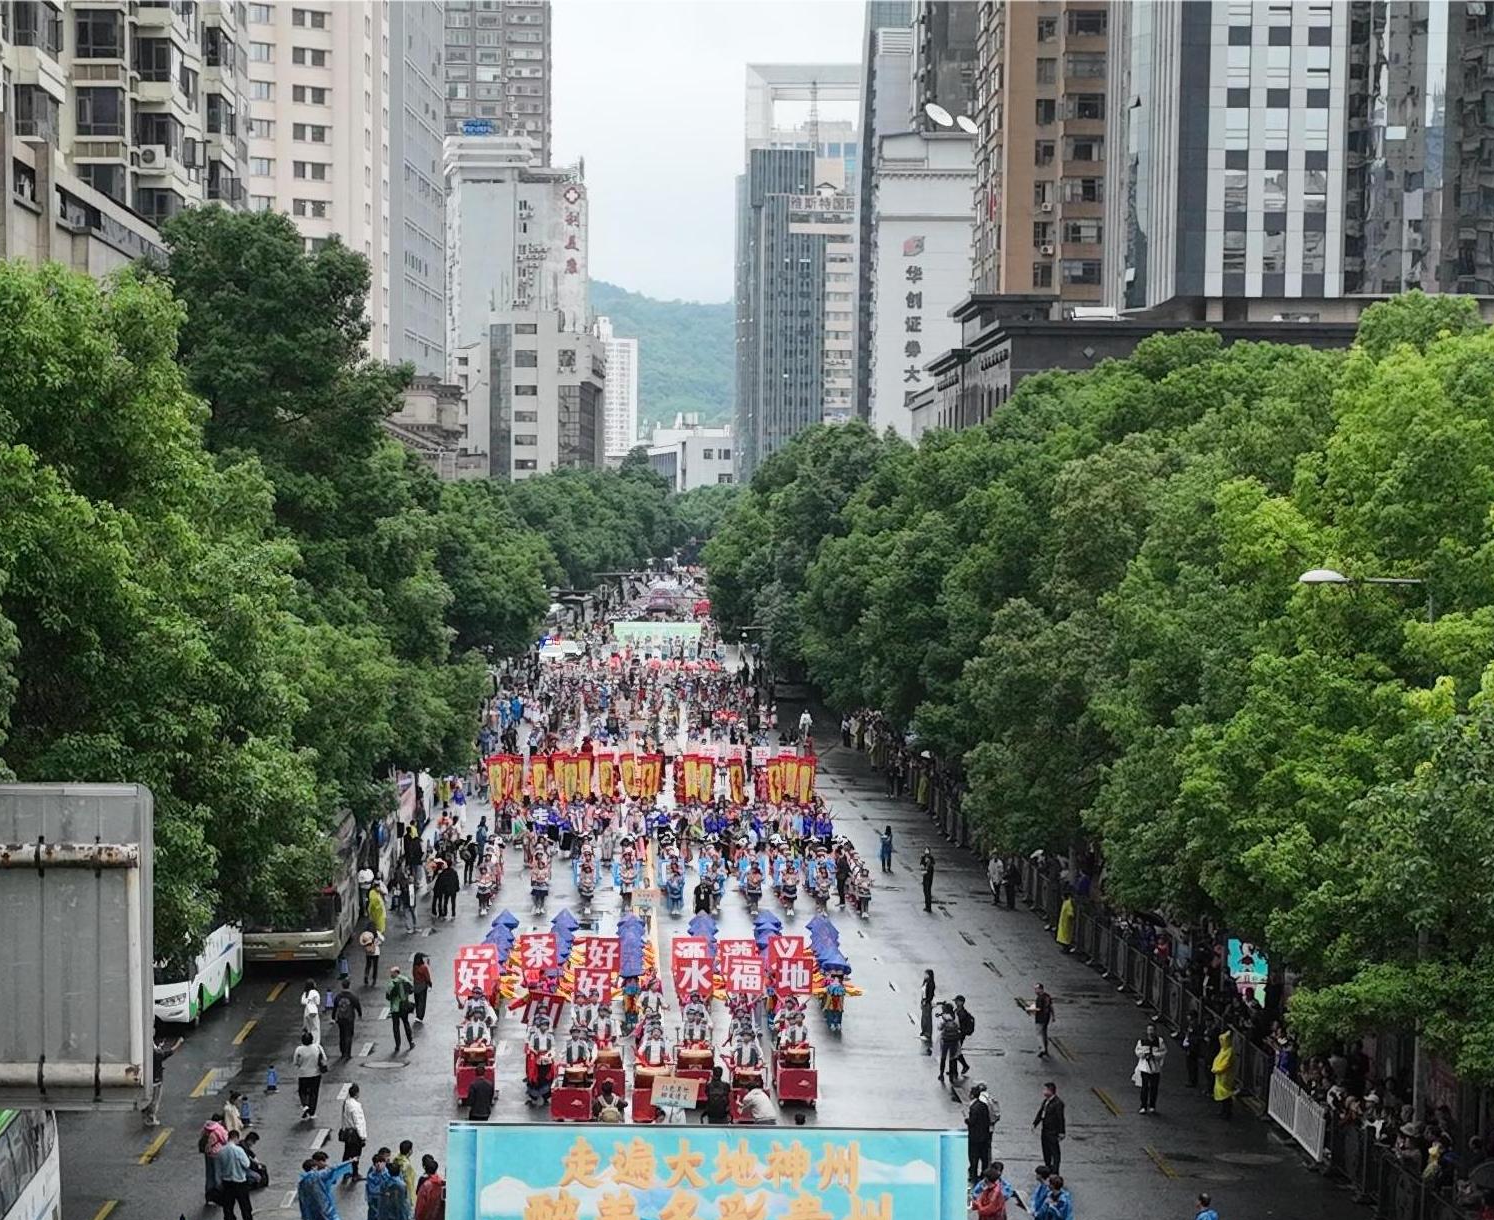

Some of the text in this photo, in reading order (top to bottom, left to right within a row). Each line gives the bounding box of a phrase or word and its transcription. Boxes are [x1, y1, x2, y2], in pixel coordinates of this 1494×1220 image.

[522, 936, 555, 968] 茶
[587, 939, 619, 969] 好
[457, 960, 490, 994] 好
[577, 970, 609, 1003] 好
[679, 959, 712, 992] 水
[729, 959, 762, 991] 福
[778, 960, 811, 992] 地
[559, 1136, 860, 1193] 走遍大地神州
